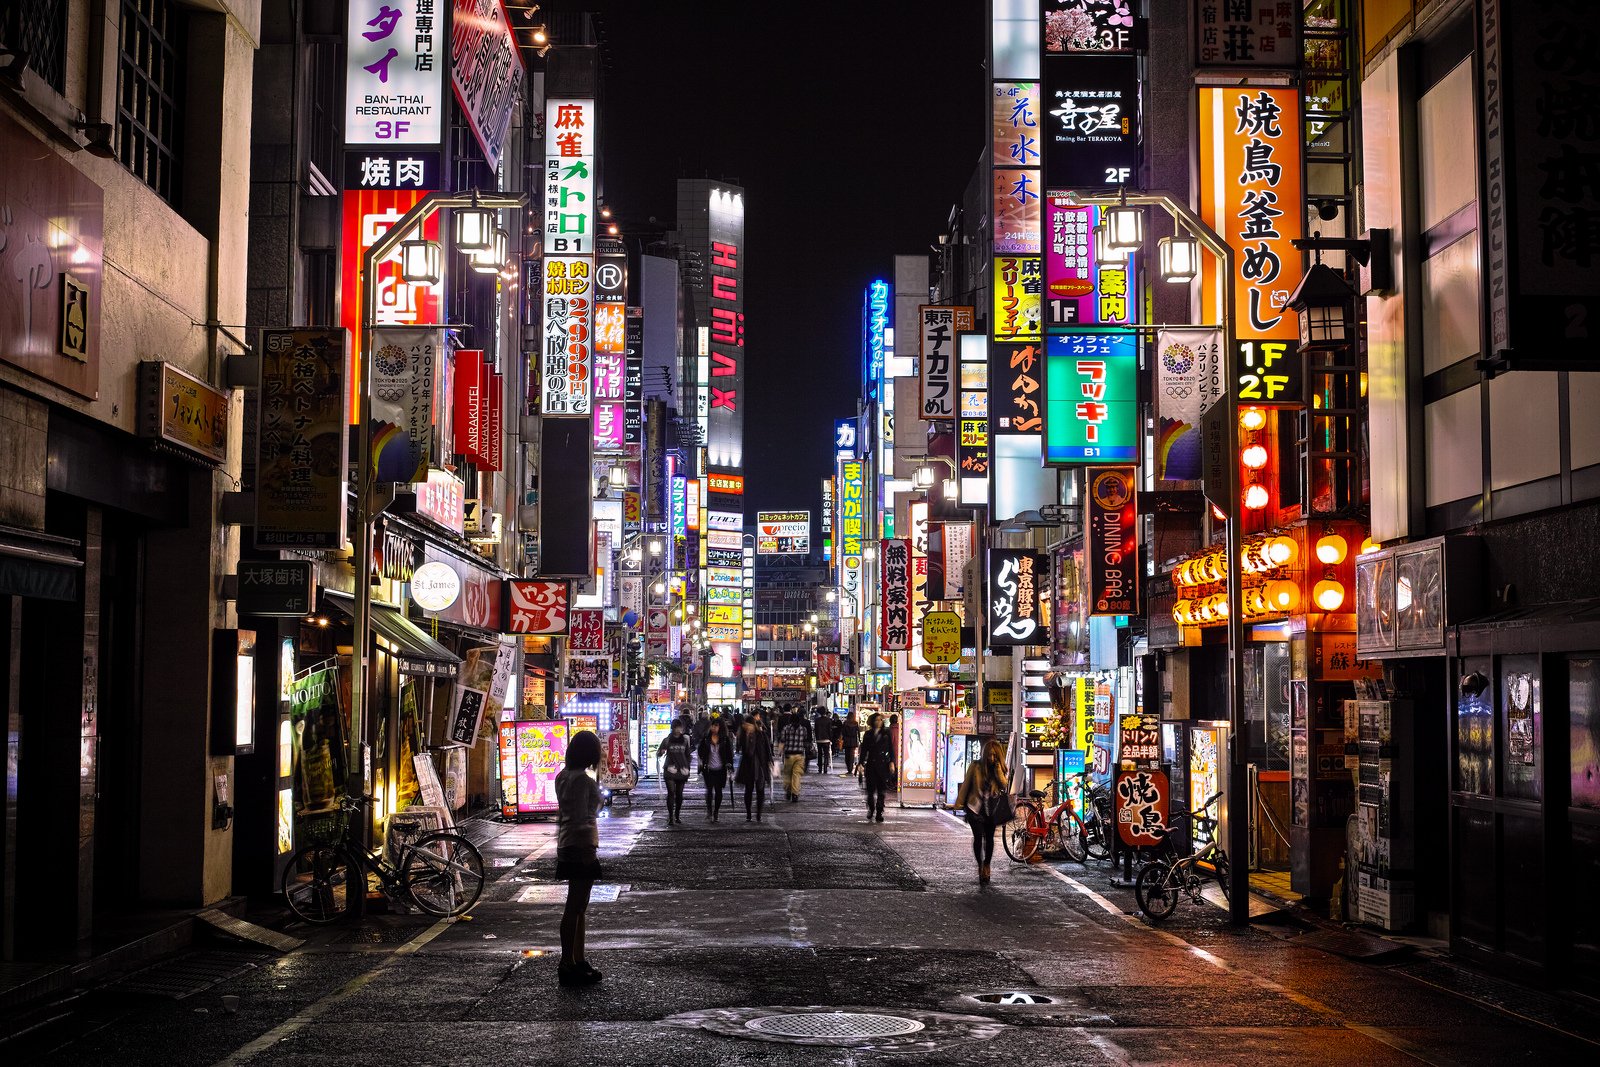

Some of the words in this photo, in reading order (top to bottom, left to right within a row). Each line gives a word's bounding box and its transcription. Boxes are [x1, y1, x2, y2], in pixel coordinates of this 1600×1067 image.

[1202, 0, 1217, 45] 宿店
[1276, 2, 1292, 39] 麻雀
[362, 5, 402, 83] タイ
[1101, 30, 1129, 50] 3F
[355, 106, 432, 116] RESTAURANT
[364, 95, 424, 105] BAN-THAI
[375, 121, 411, 139] 3F
[554, 104, 585, 158] 麻雀
[361, 157, 424, 187] 焼肉
[1105, 168, 1131, 183] 2F
[548, 160, 559, 234] 四名様専門店
[1235, 91, 1284, 331] 焼鳥釜めし
[1053, 211, 1064, 255] ホテル可
[1490, 159, 1505, 300] HONJIN
[554, 238, 582, 252] B1
[547, 261, 588, 279] 焼肉
[546, 279, 589, 295] ホルモン
[1099, 269, 1127, 322] 案内
[924, 310, 953, 325] 東京
[1050, 300, 1075, 322] 1F
[266, 335, 292, 353] 5F
[545, 298, 567, 413] 食べ放題の店
[1059, 335, 1124, 347] オンライン
[1073, 345, 1110, 354] カフェ
[1240, 341, 1287, 368] 1F
[609, 355, 621, 398] レンタル
[927, 325, 951, 399] チカラ
[1211, 343, 1220, 396] 2020年
[595, 367, 607, 398] ルーム
[1239, 374, 1289, 400] 2F
[290, 345, 317, 484] 本格ベトナム料理
[924, 399, 953, 415] めし
[1076, 360, 1109, 443] ラッキー
[470, 386, 479, 450] ANRAKUTEI
[599, 404, 613, 437] エデン
[1084, 447, 1100, 457] B1
[709, 479, 742, 490] 全店営業中
[673, 478, 685, 526] カラオケ
[844, 462, 862, 555] まんが喫茶
[1103, 512, 1122, 566] DINING
[243, 569, 304, 586] 大塚歯科
[1018, 556, 1034, 618] 東京豚骨
[1104, 569, 1122, 599] BAR
[285, 599, 301, 610] 4F
[886, 545, 908, 645] 無料案内所
[1030, 740, 1041, 749] 1F
[1122, 730, 1158, 743] ドリンク
[1122, 745, 1158, 758] 全品半額
[1119, 773, 1166, 840] 焼鳥
